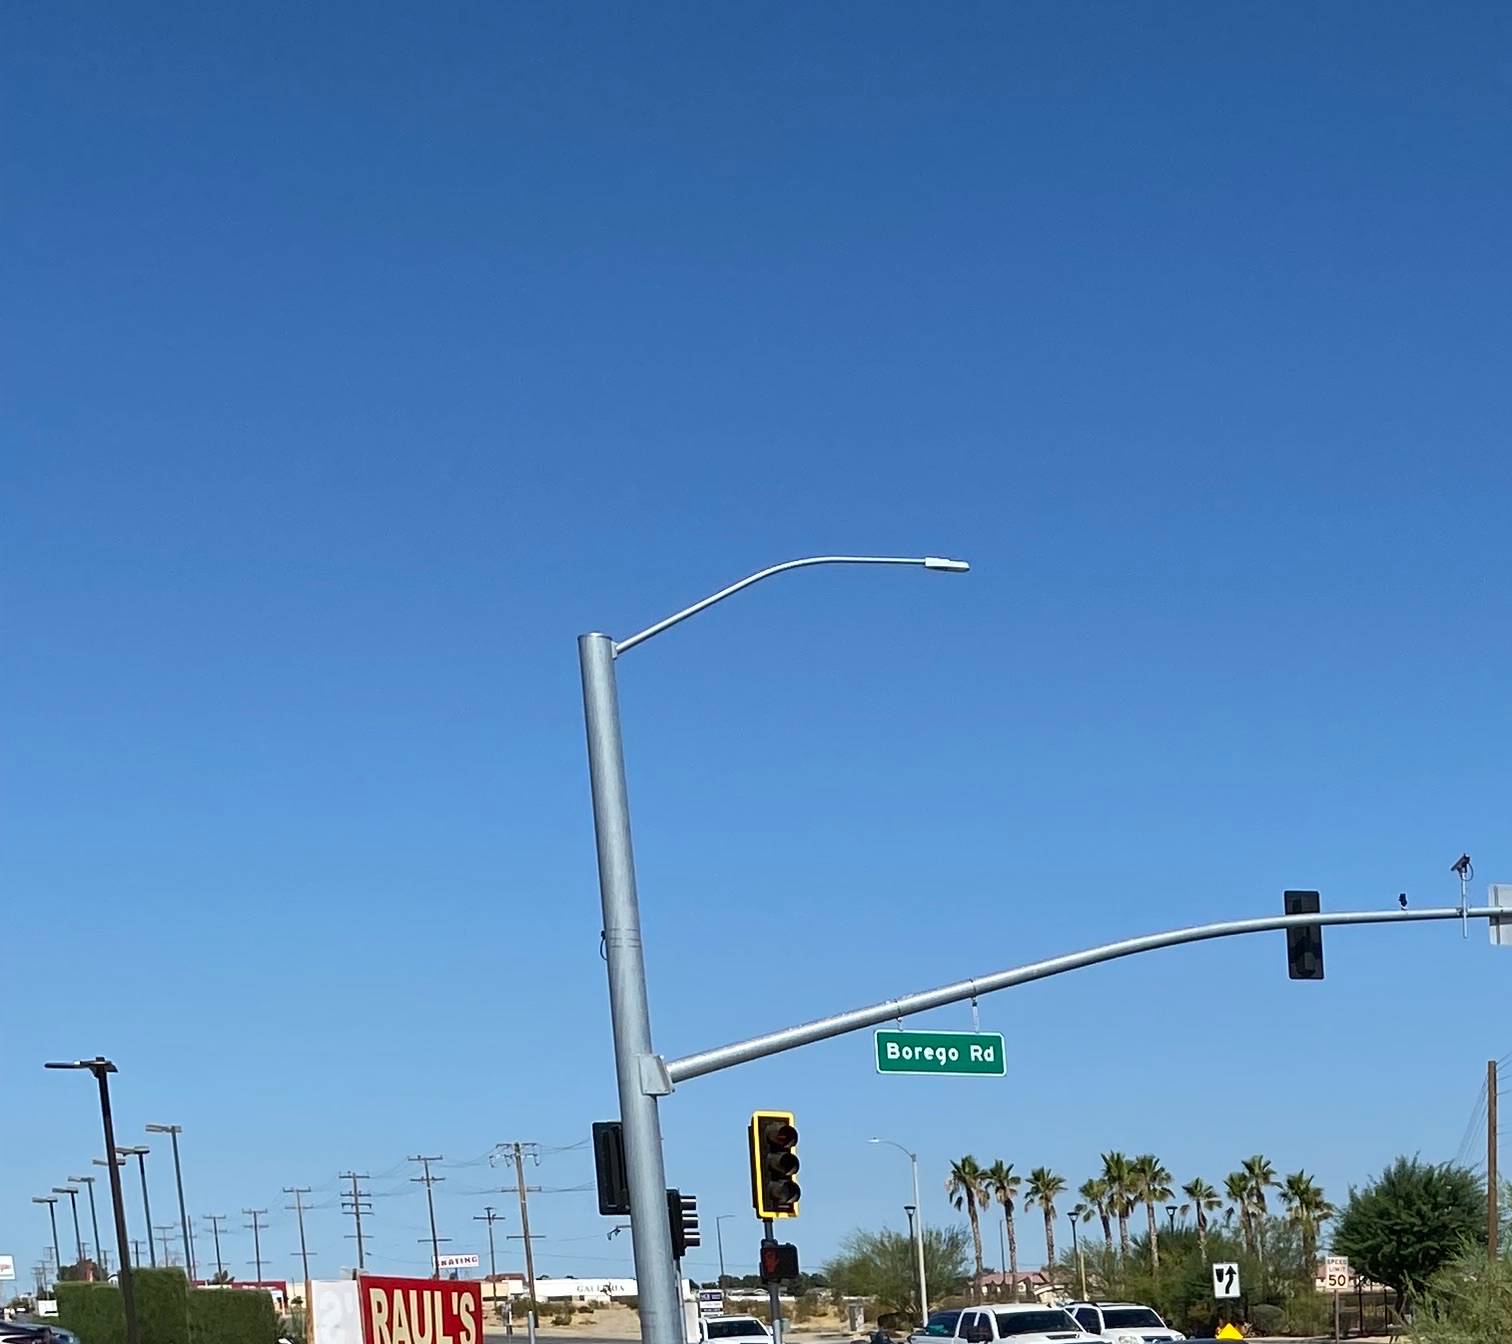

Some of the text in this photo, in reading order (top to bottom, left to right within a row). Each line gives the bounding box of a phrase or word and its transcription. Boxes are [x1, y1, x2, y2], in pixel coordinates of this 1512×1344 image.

[886, 1042, 995, 1066] Borego Rd
[437, 1256, 478, 1267] KATING
[1328, 1274, 1346, 1287] 50
